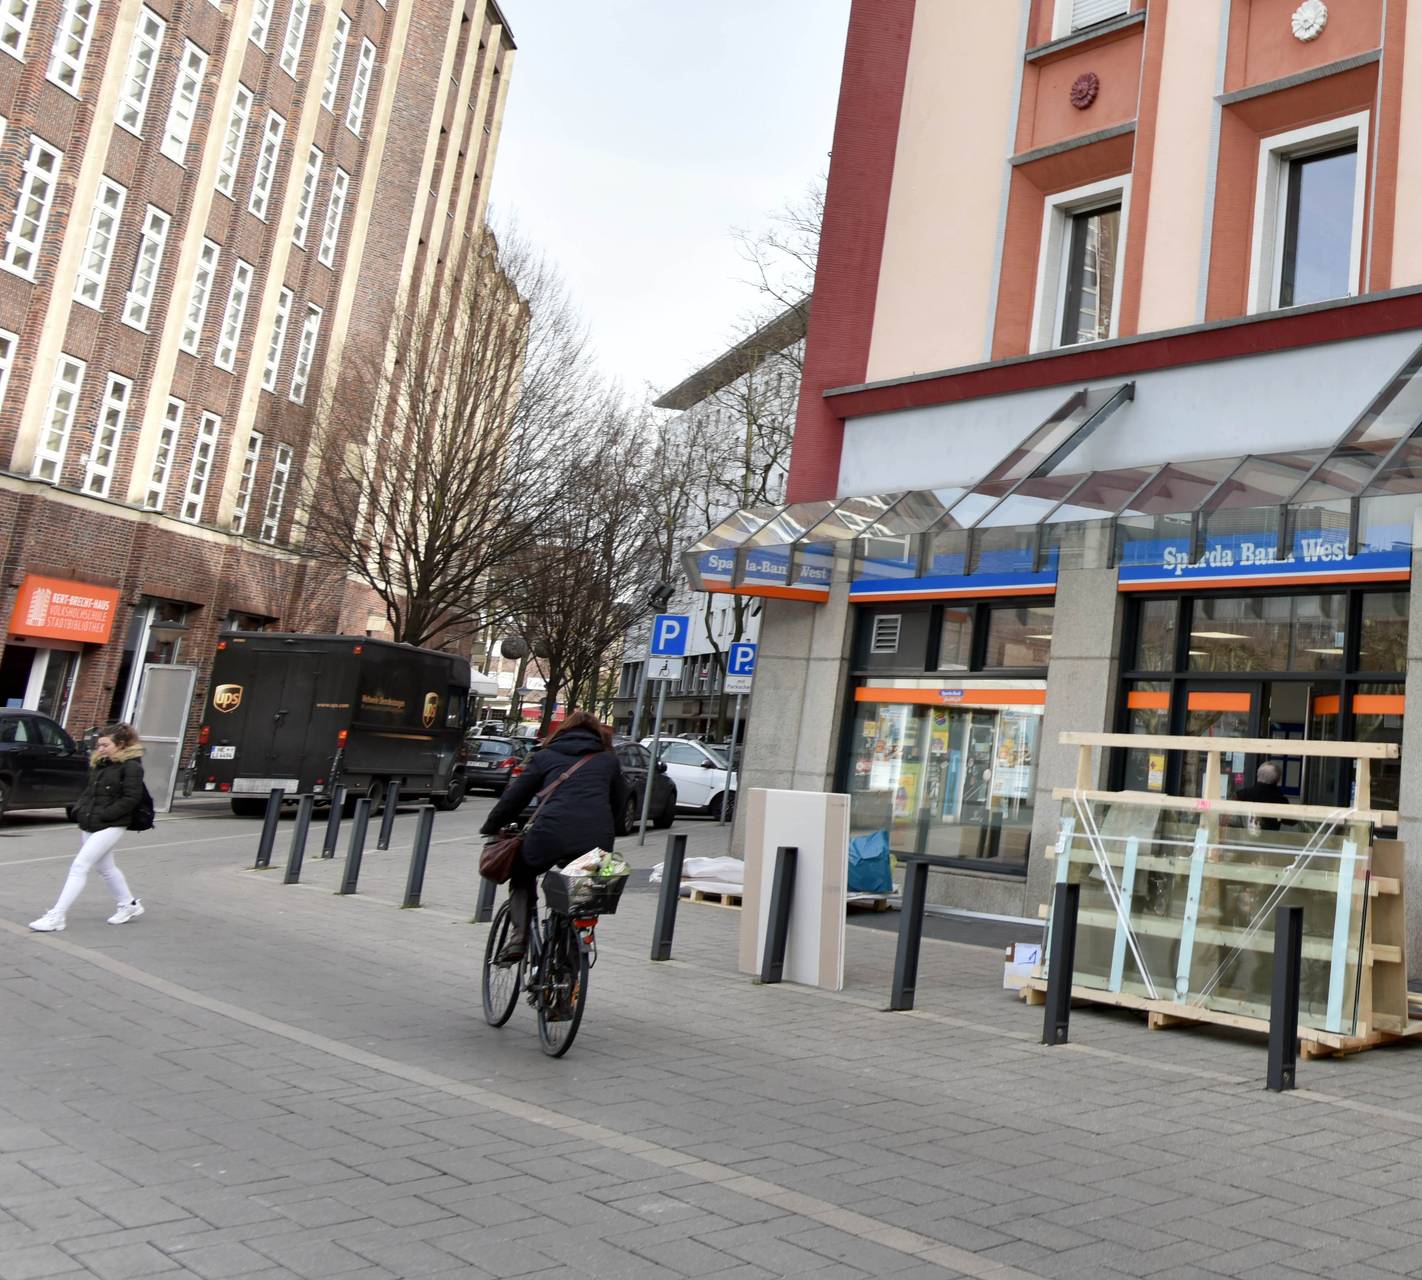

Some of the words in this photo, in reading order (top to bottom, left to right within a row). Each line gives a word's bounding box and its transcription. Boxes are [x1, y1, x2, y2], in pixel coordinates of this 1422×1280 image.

[1163, 544, 1234, 576] Sprda
[1302, 537, 1354, 562] West
[52, 592, 110, 610] BERT-BRECHT-HAUS
[47, 616, 105, 633] STADTBIBLIOTHEK
[659, 620, 680, 650] P
[734, 647, 754, 671] P
[216, 692, 241, 708] ups
